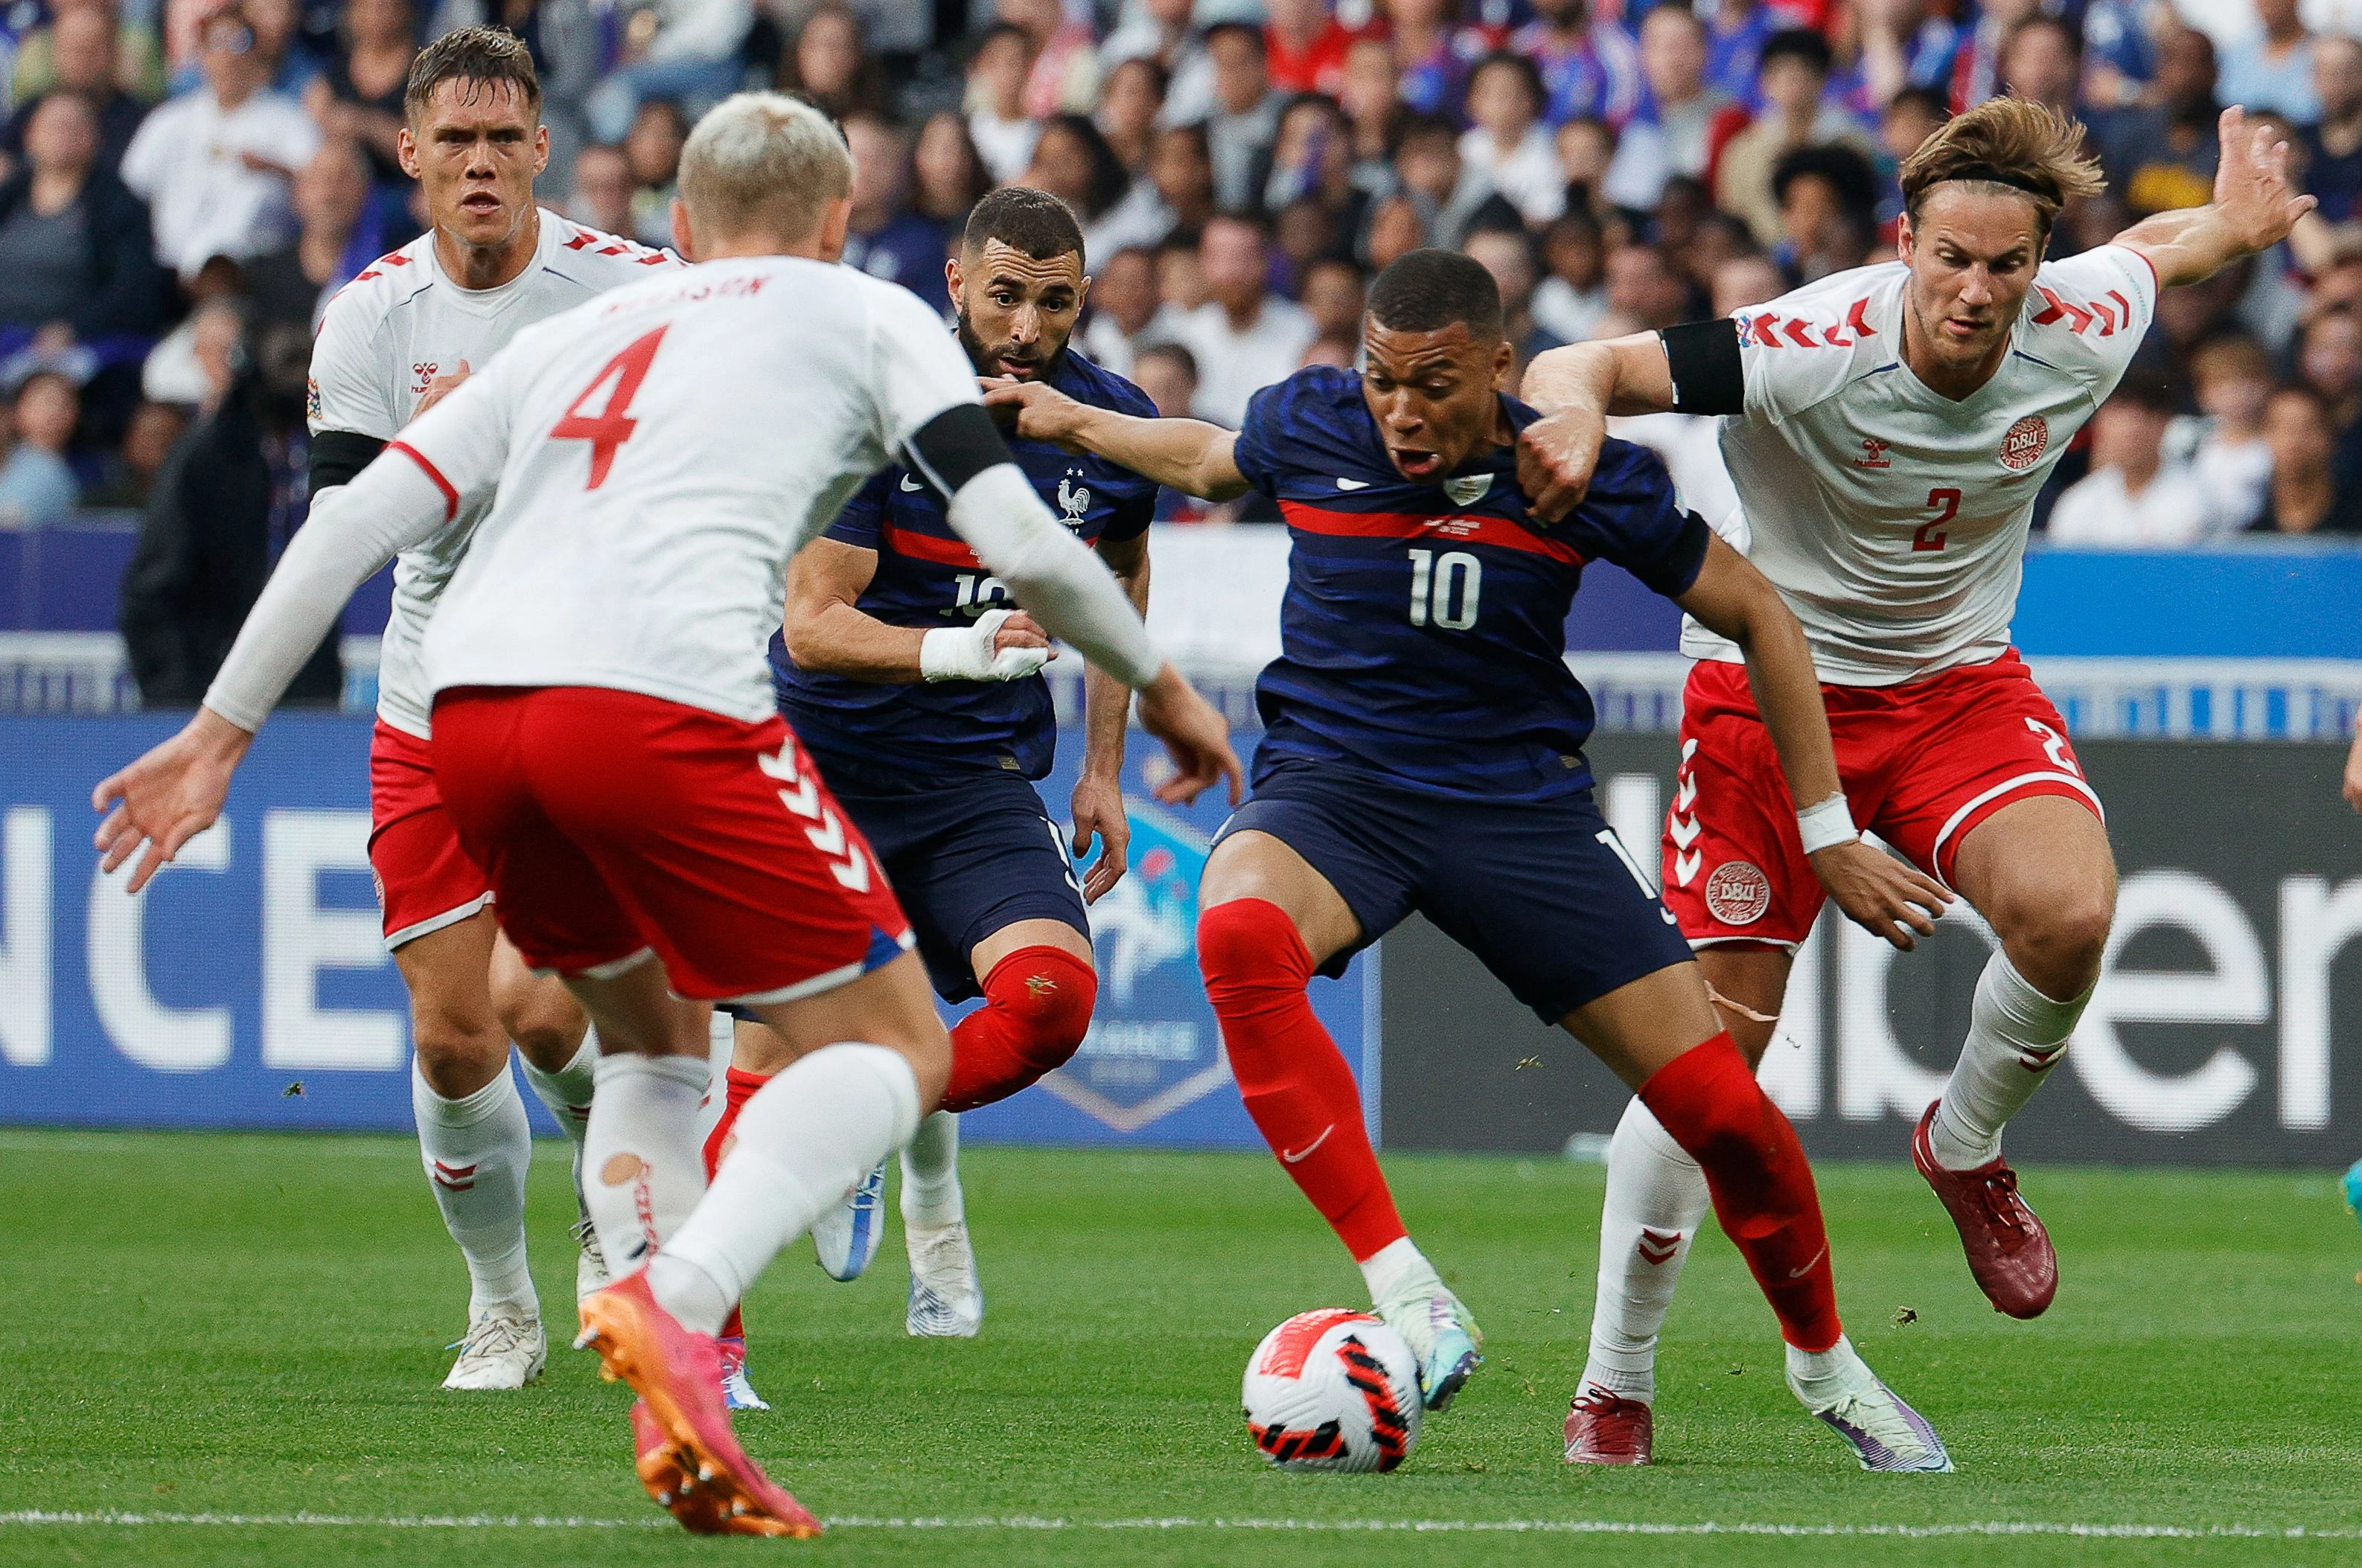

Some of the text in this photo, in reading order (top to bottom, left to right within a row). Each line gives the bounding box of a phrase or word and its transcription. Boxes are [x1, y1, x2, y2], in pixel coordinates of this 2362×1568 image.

[548, 323, 671, 491] 4
[2009, 430, 2038, 452] DBU
[1912, 488, 1962, 551] 2
[1408, 548, 1481, 630] 10
[2024, 717, 2079, 777] 2
[1720, 883, 1756, 901] DBU
